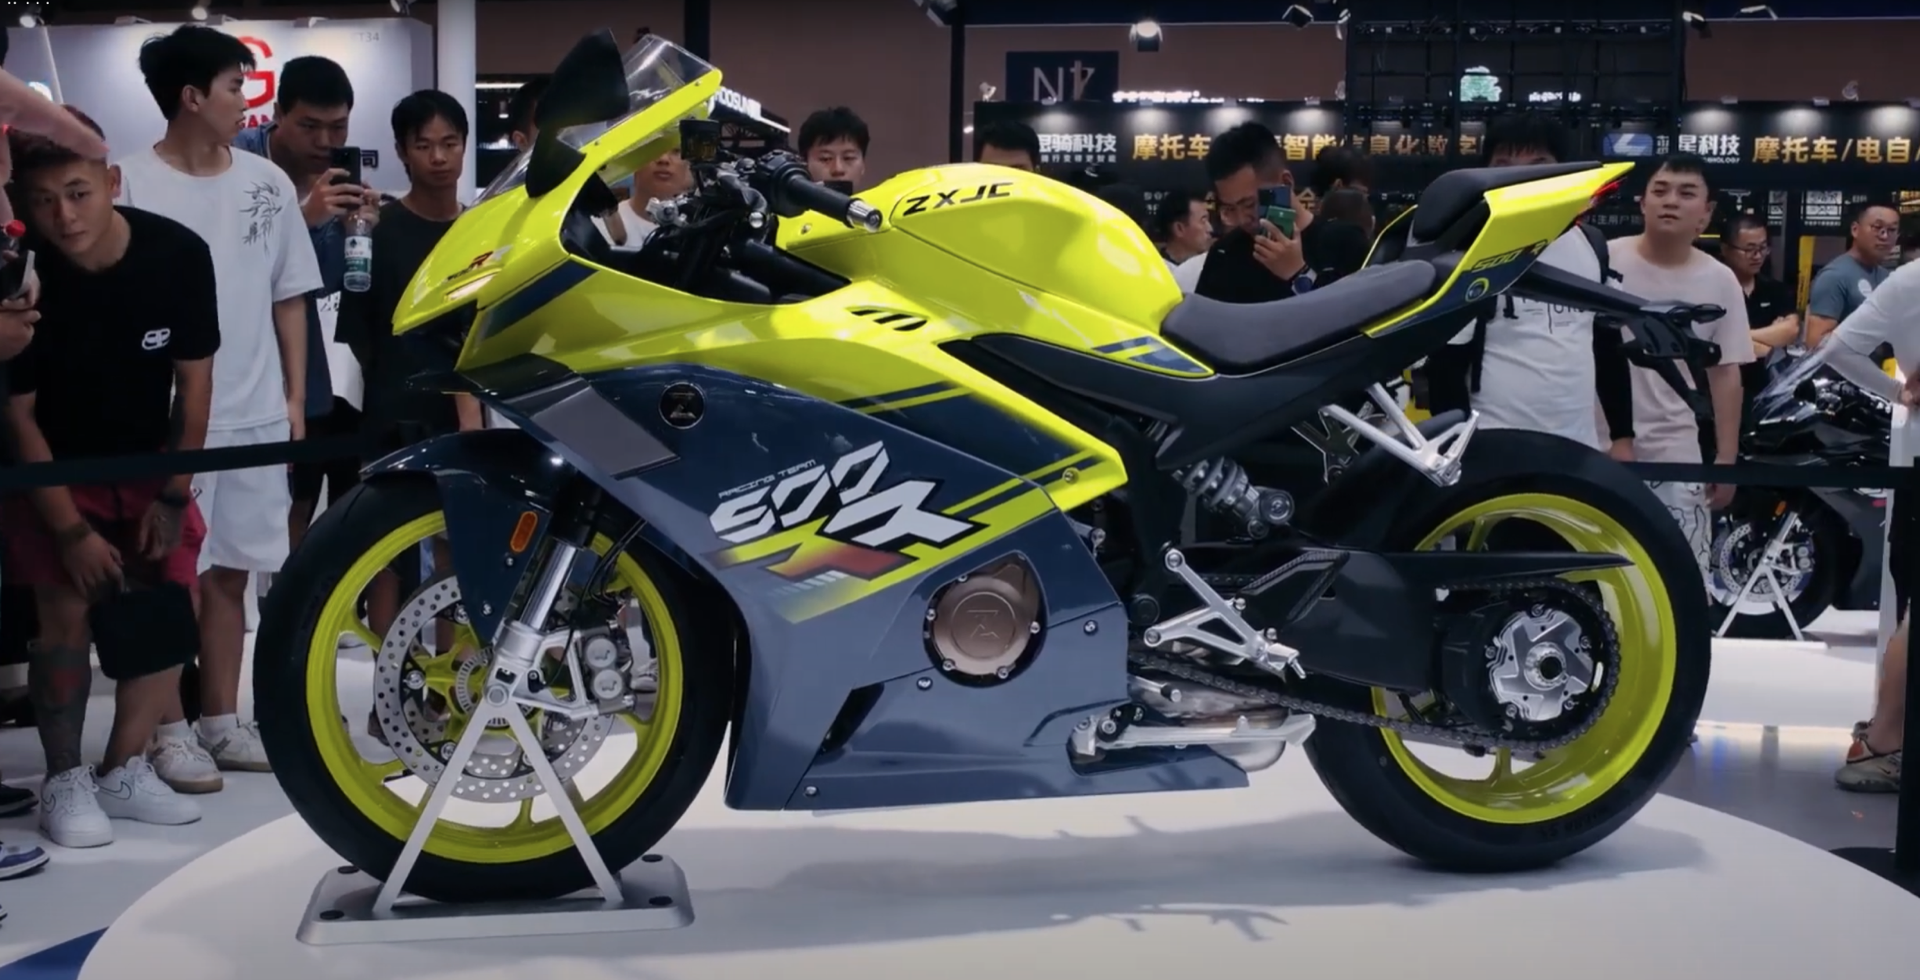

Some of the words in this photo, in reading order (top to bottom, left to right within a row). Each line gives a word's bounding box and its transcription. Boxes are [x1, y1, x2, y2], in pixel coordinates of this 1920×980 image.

[902, 182, 1014, 217] ZXJC
[718, 474, 776, 499] RACING
[777, 459, 817, 477] TEAM
